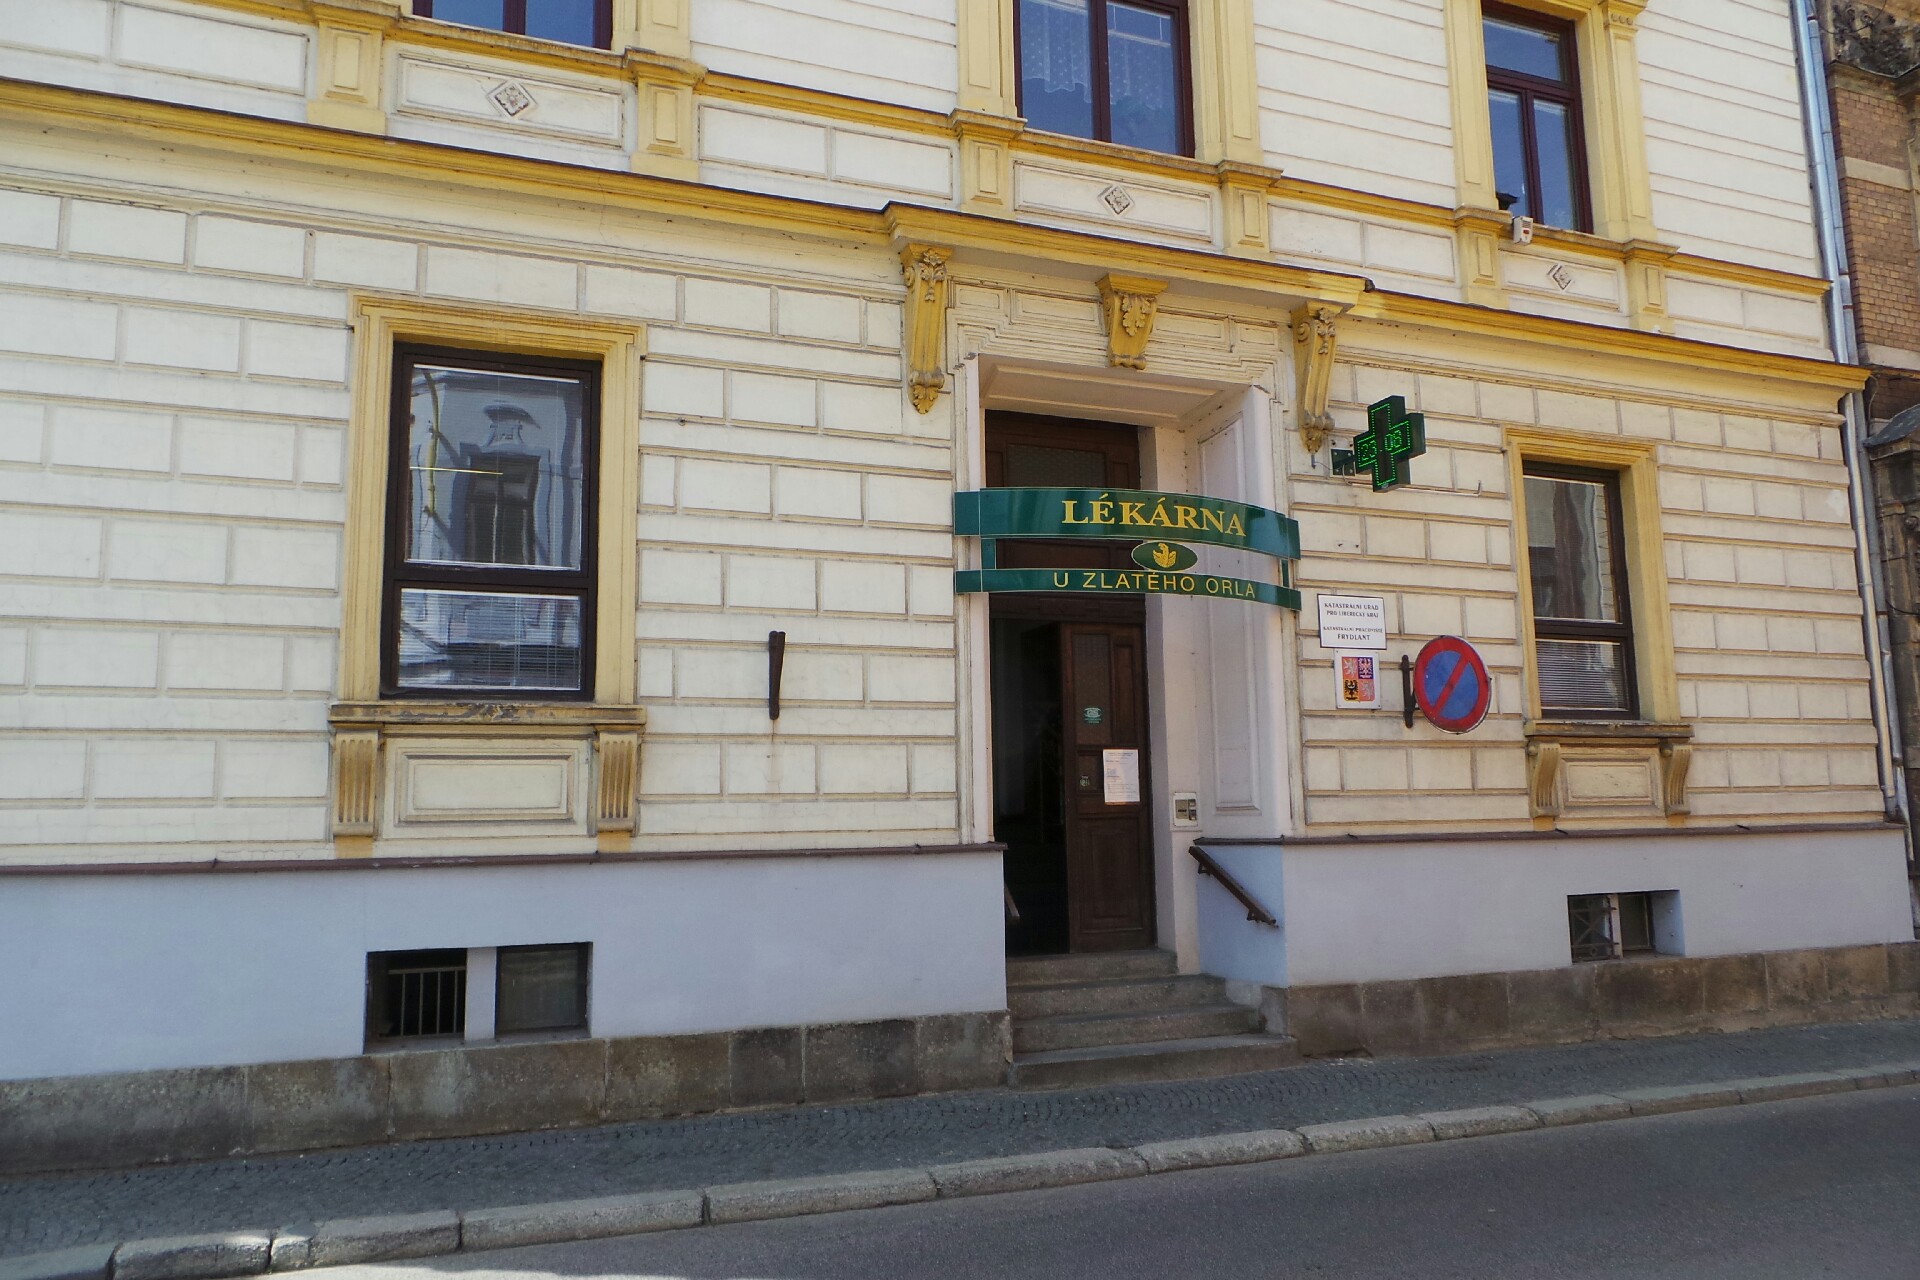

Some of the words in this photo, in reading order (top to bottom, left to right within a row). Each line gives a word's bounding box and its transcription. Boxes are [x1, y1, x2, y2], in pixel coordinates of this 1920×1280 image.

[1061, 493, 1246, 537] LÉKÁRNA
[1053, 572, 1069, 588] U
[1082, 570, 1195, 592] ZLATÉHO
[1205, 577, 1256, 599] ORLA
